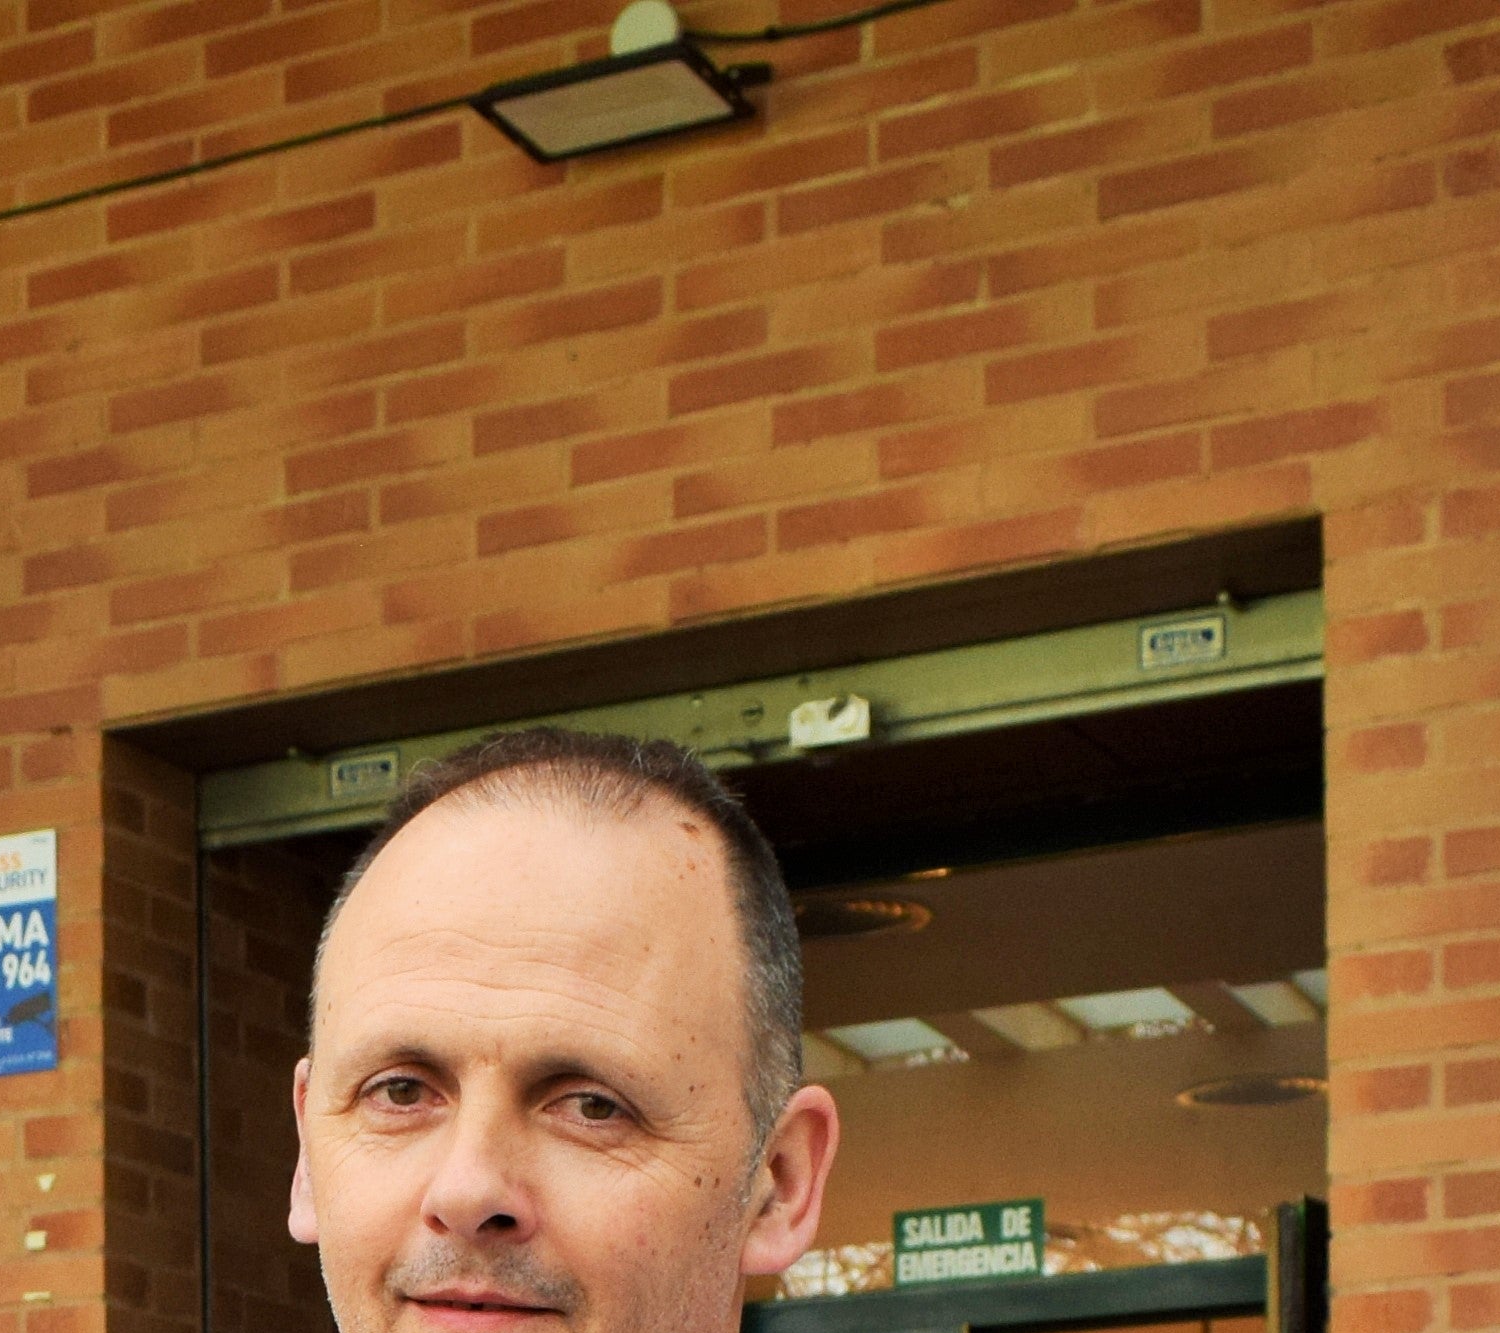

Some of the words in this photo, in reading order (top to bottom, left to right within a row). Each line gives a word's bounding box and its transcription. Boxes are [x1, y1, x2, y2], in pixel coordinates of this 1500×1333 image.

[2, 948, 51, 989] 964
[903, 1211, 984, 1249] SALIDA
[1000, 1206, 1032, 1239] DE
[898, 1241, 1037, 1284] EMERGENCIA
